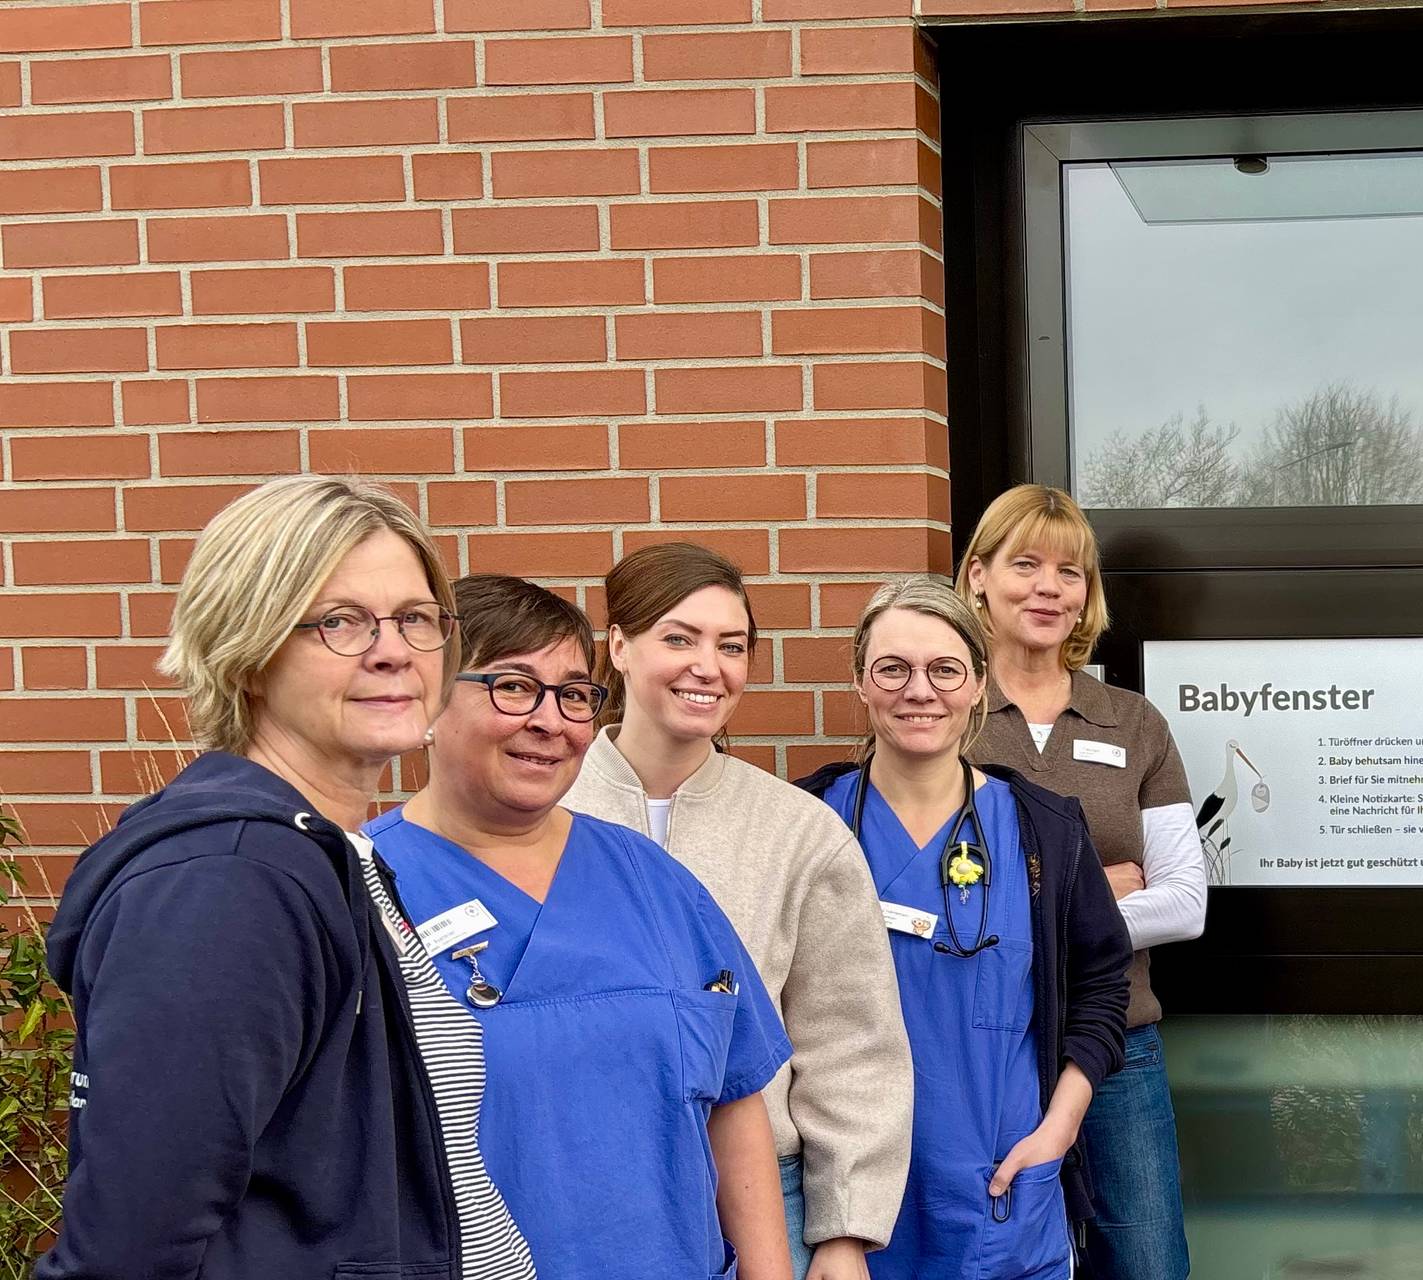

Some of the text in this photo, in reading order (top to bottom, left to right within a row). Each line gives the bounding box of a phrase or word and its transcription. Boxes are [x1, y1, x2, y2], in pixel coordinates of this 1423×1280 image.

[1178, 683, 1375, 717] Babyfenster
[1317, 737, 1327, 747] 1.
[1328, 736, 1373, 747] Türöffner
[1374, 736, 1414, 747] drücken
[1317, 756, 1327, 766] 2.
[1329, 756, 1353, 768] Baby
[1354, 755, 1402, 766] behutsam
[1317, 775, 1328, 785] 3.
[1329, 775, 1353, 785] Brief
[1354, 774, 1369, 785] für
[1370, 774, 1386, 784] Sie
[1318, 795, 1328, 804] 4.
[1329, 794, 1360, 804] Kleine
[1362, 793, 1416, 804] Notizkarte:
[1329, 806, 1350, 815] eine
[1352, 806, 1399, 815] Nachricht
[1400, 805, 1415, 815] für
[1319, 825, 1328, 835] 5.
[1329, 825, 1346, 835] Tür
[1347, 824, 1393, 835] schließen
[1402, 824, 1417, 834] sie
[1259, 858, 1275, 868] Ihr
[1276, 858, 1303, 870] Baby
[1305, 858, 1319, 868] ist
[1319, 857, 1345, 870] jetzt
[1346, 858, 1365, 870] gut
[1366, 856, 1418, 870] geschützt
